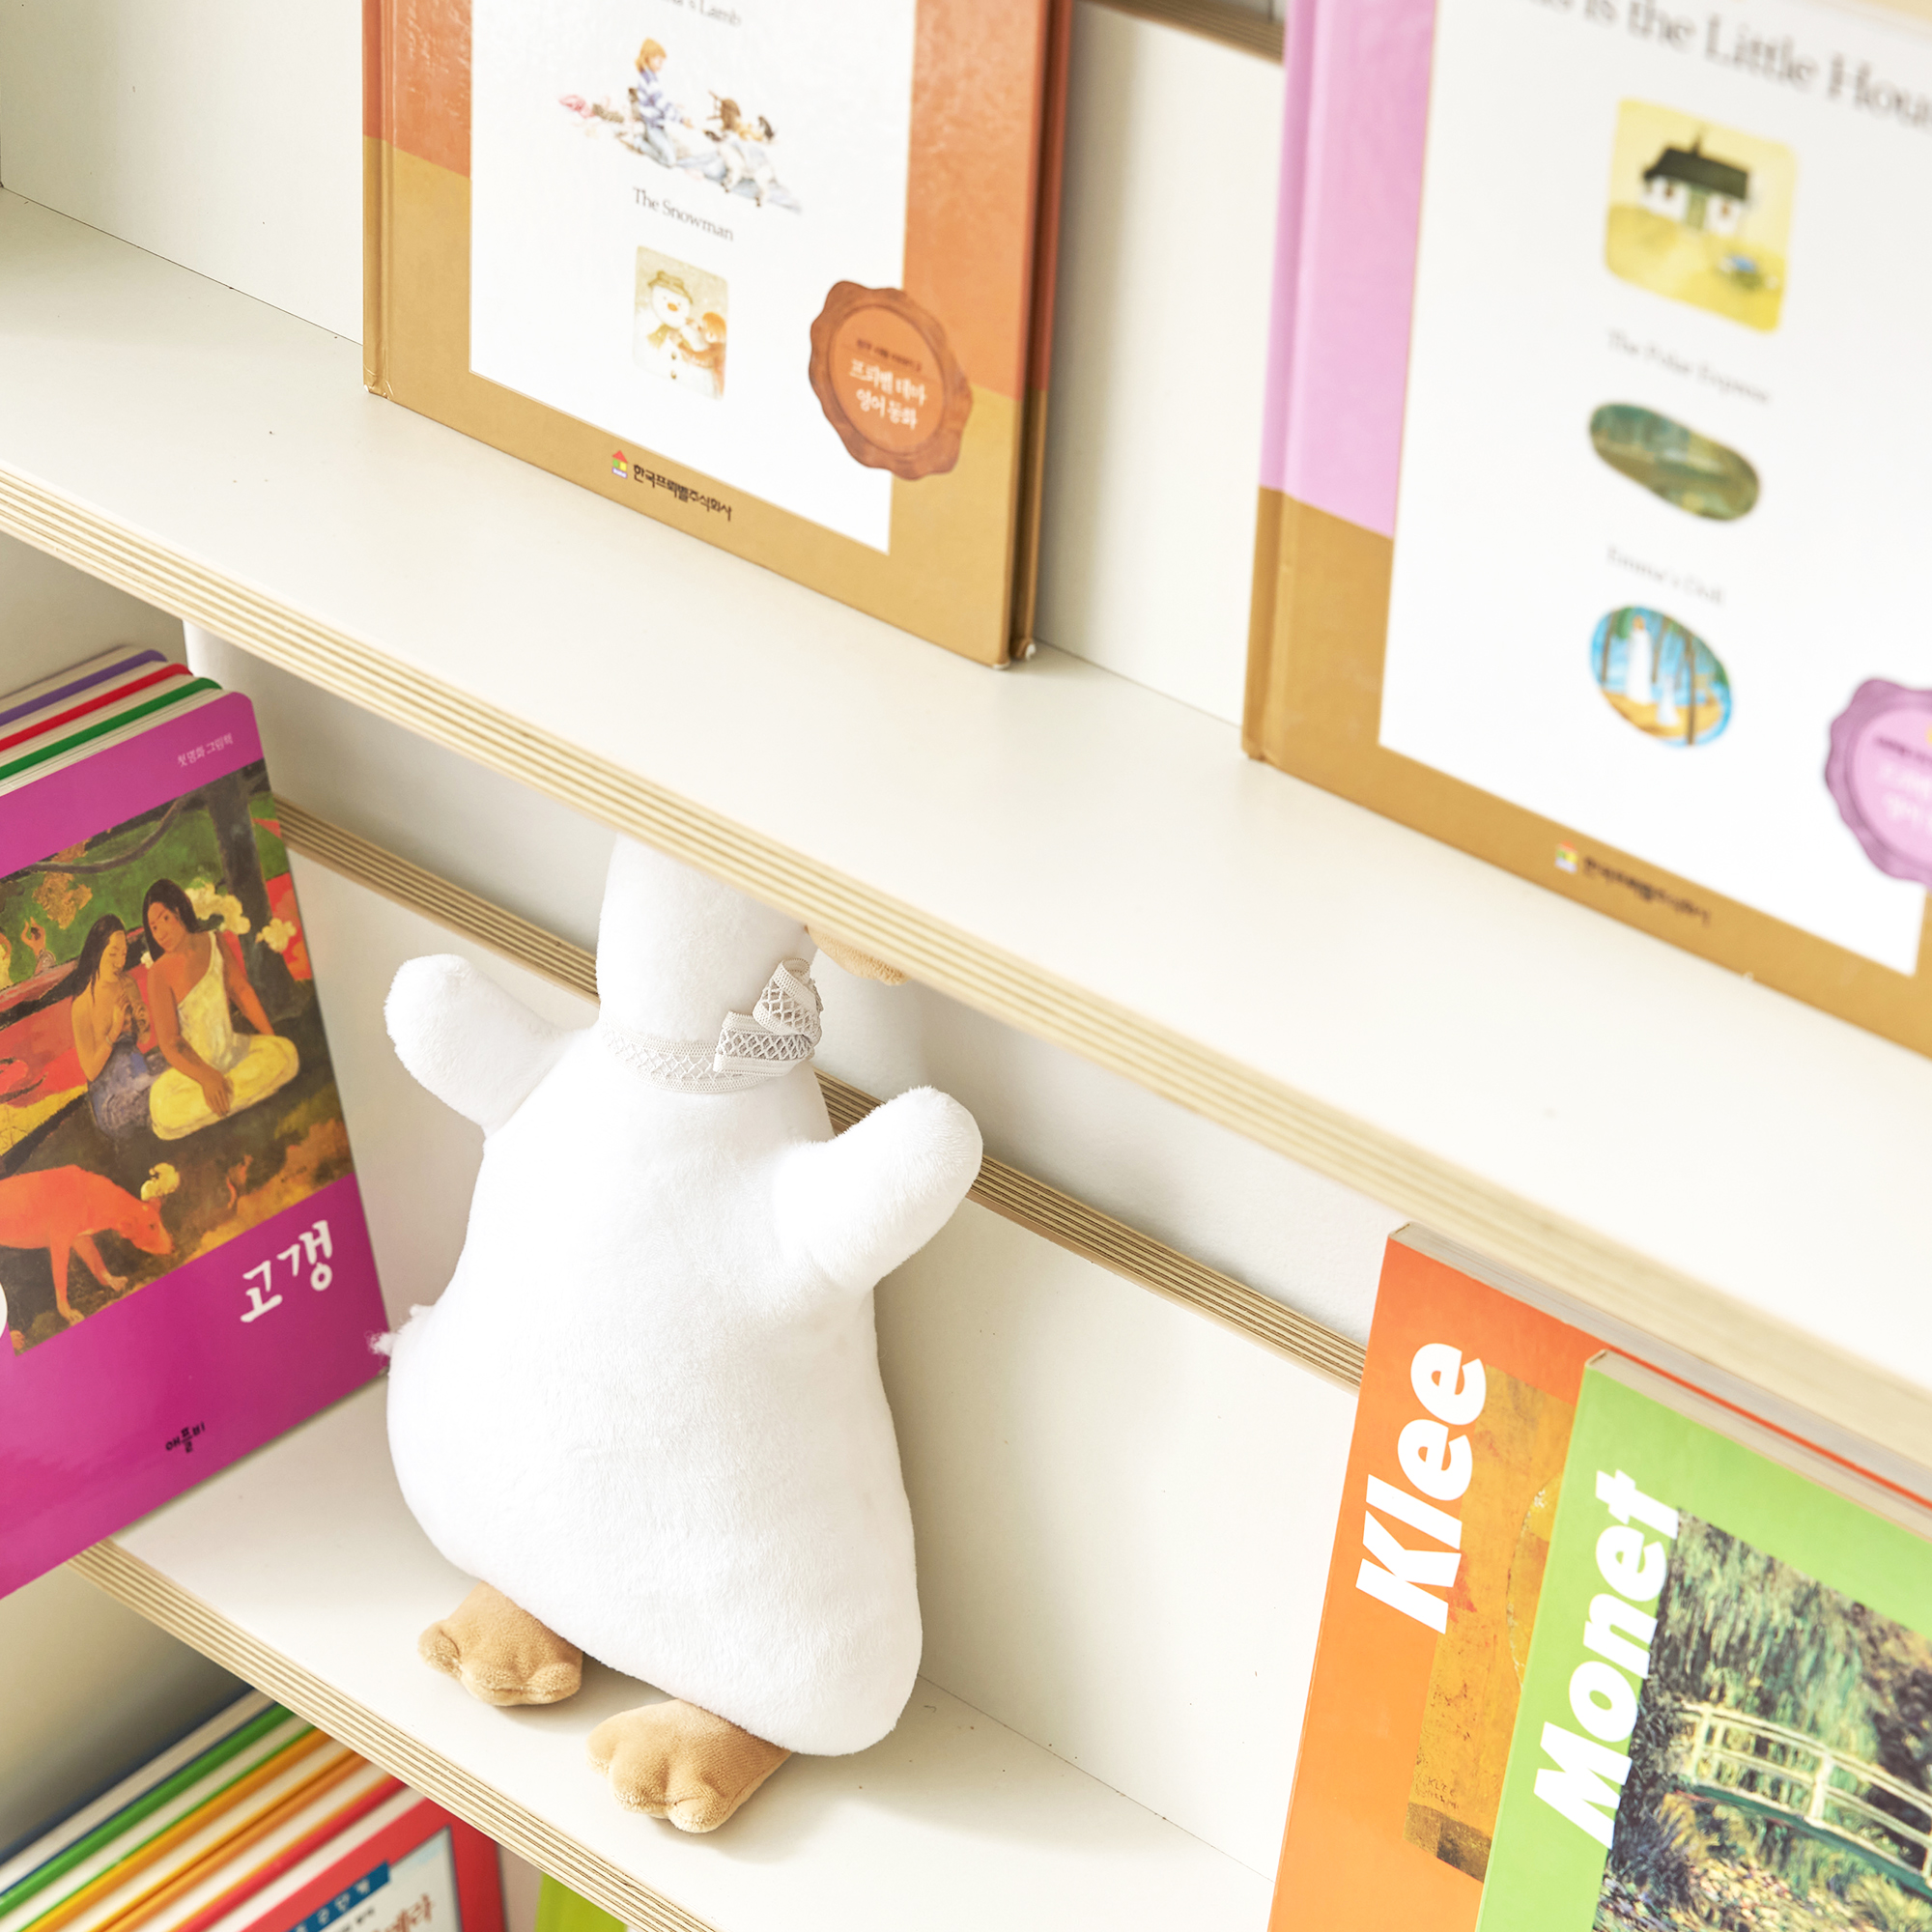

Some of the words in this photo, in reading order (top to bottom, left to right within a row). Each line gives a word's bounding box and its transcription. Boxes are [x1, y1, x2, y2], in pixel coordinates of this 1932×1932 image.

[1628, 0, 1697, 53] the
[1704, 12, 1819, 93] Little
[633, 186, 660, 212] The
[663, 199, 734, 242] Snowman
[849, 358, 894, 395] 프뢰벨
[856, 387, 886, 419] 영어
[633, 464, 732, 522] 한국프뢰벨주식회사
[241, 1220, 333, 1322] 고갱
[165, 1420, 205, 1454] 애플비
[1354, 1342, 1487, 1634] Klee
[1534, 1468, 1679, 1849] Monet
